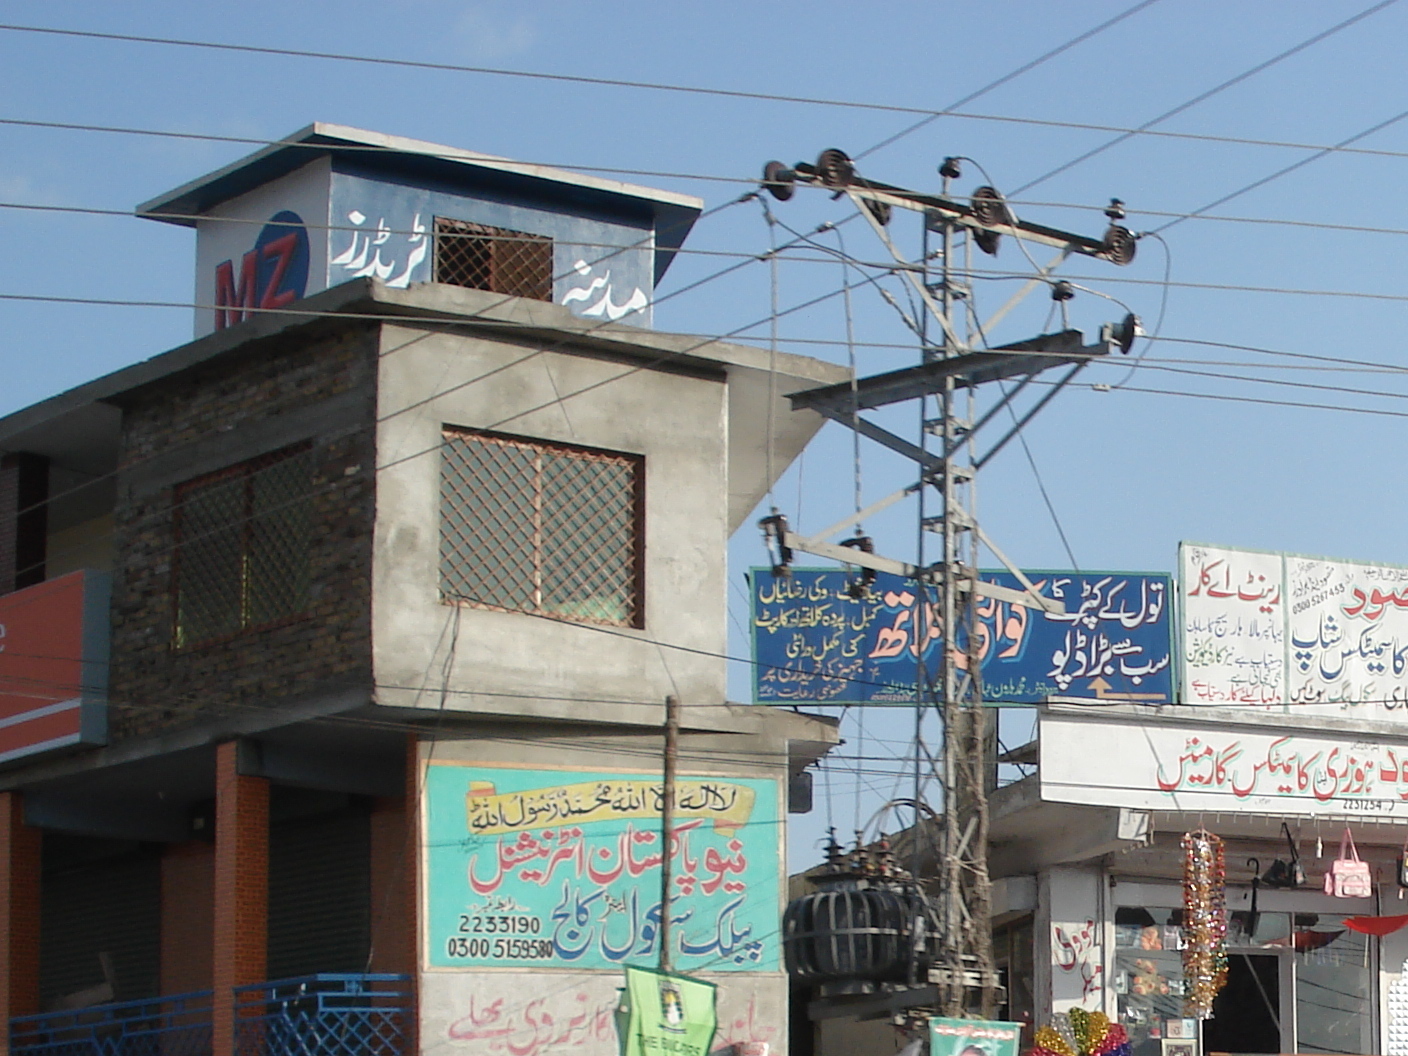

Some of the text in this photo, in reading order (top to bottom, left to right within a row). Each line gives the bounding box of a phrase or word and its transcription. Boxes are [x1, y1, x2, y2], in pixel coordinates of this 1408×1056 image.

[214, 232, 298, 331] MZ
[559, 258, 648, 321] مدینہ
[1187, 558, 1225, 598] کار
[1110, 637, 1143, 656] سے
[1119, 652, 1170, 686] سب
[701, 838, 748, 897] نیو
[459, 915, 541, 934] 2233190
[448, 937, 490, 958] 0300
